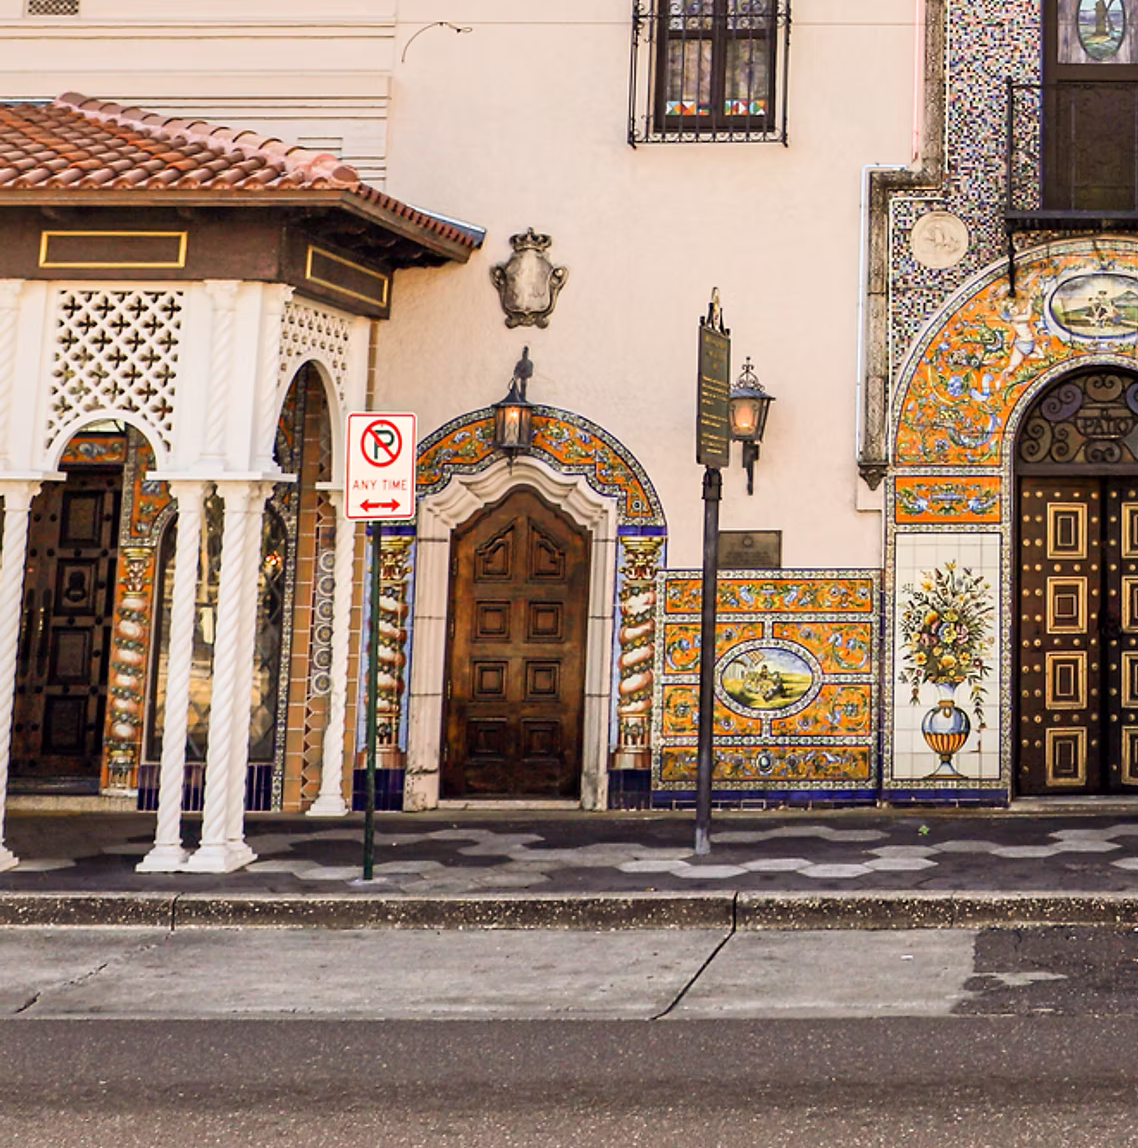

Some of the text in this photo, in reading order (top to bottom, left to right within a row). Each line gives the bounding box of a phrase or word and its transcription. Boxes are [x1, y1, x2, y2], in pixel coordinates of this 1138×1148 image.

[1082, 418, 1129, 435] PATIO
[352, 479, 408, 491] ANY TIME
